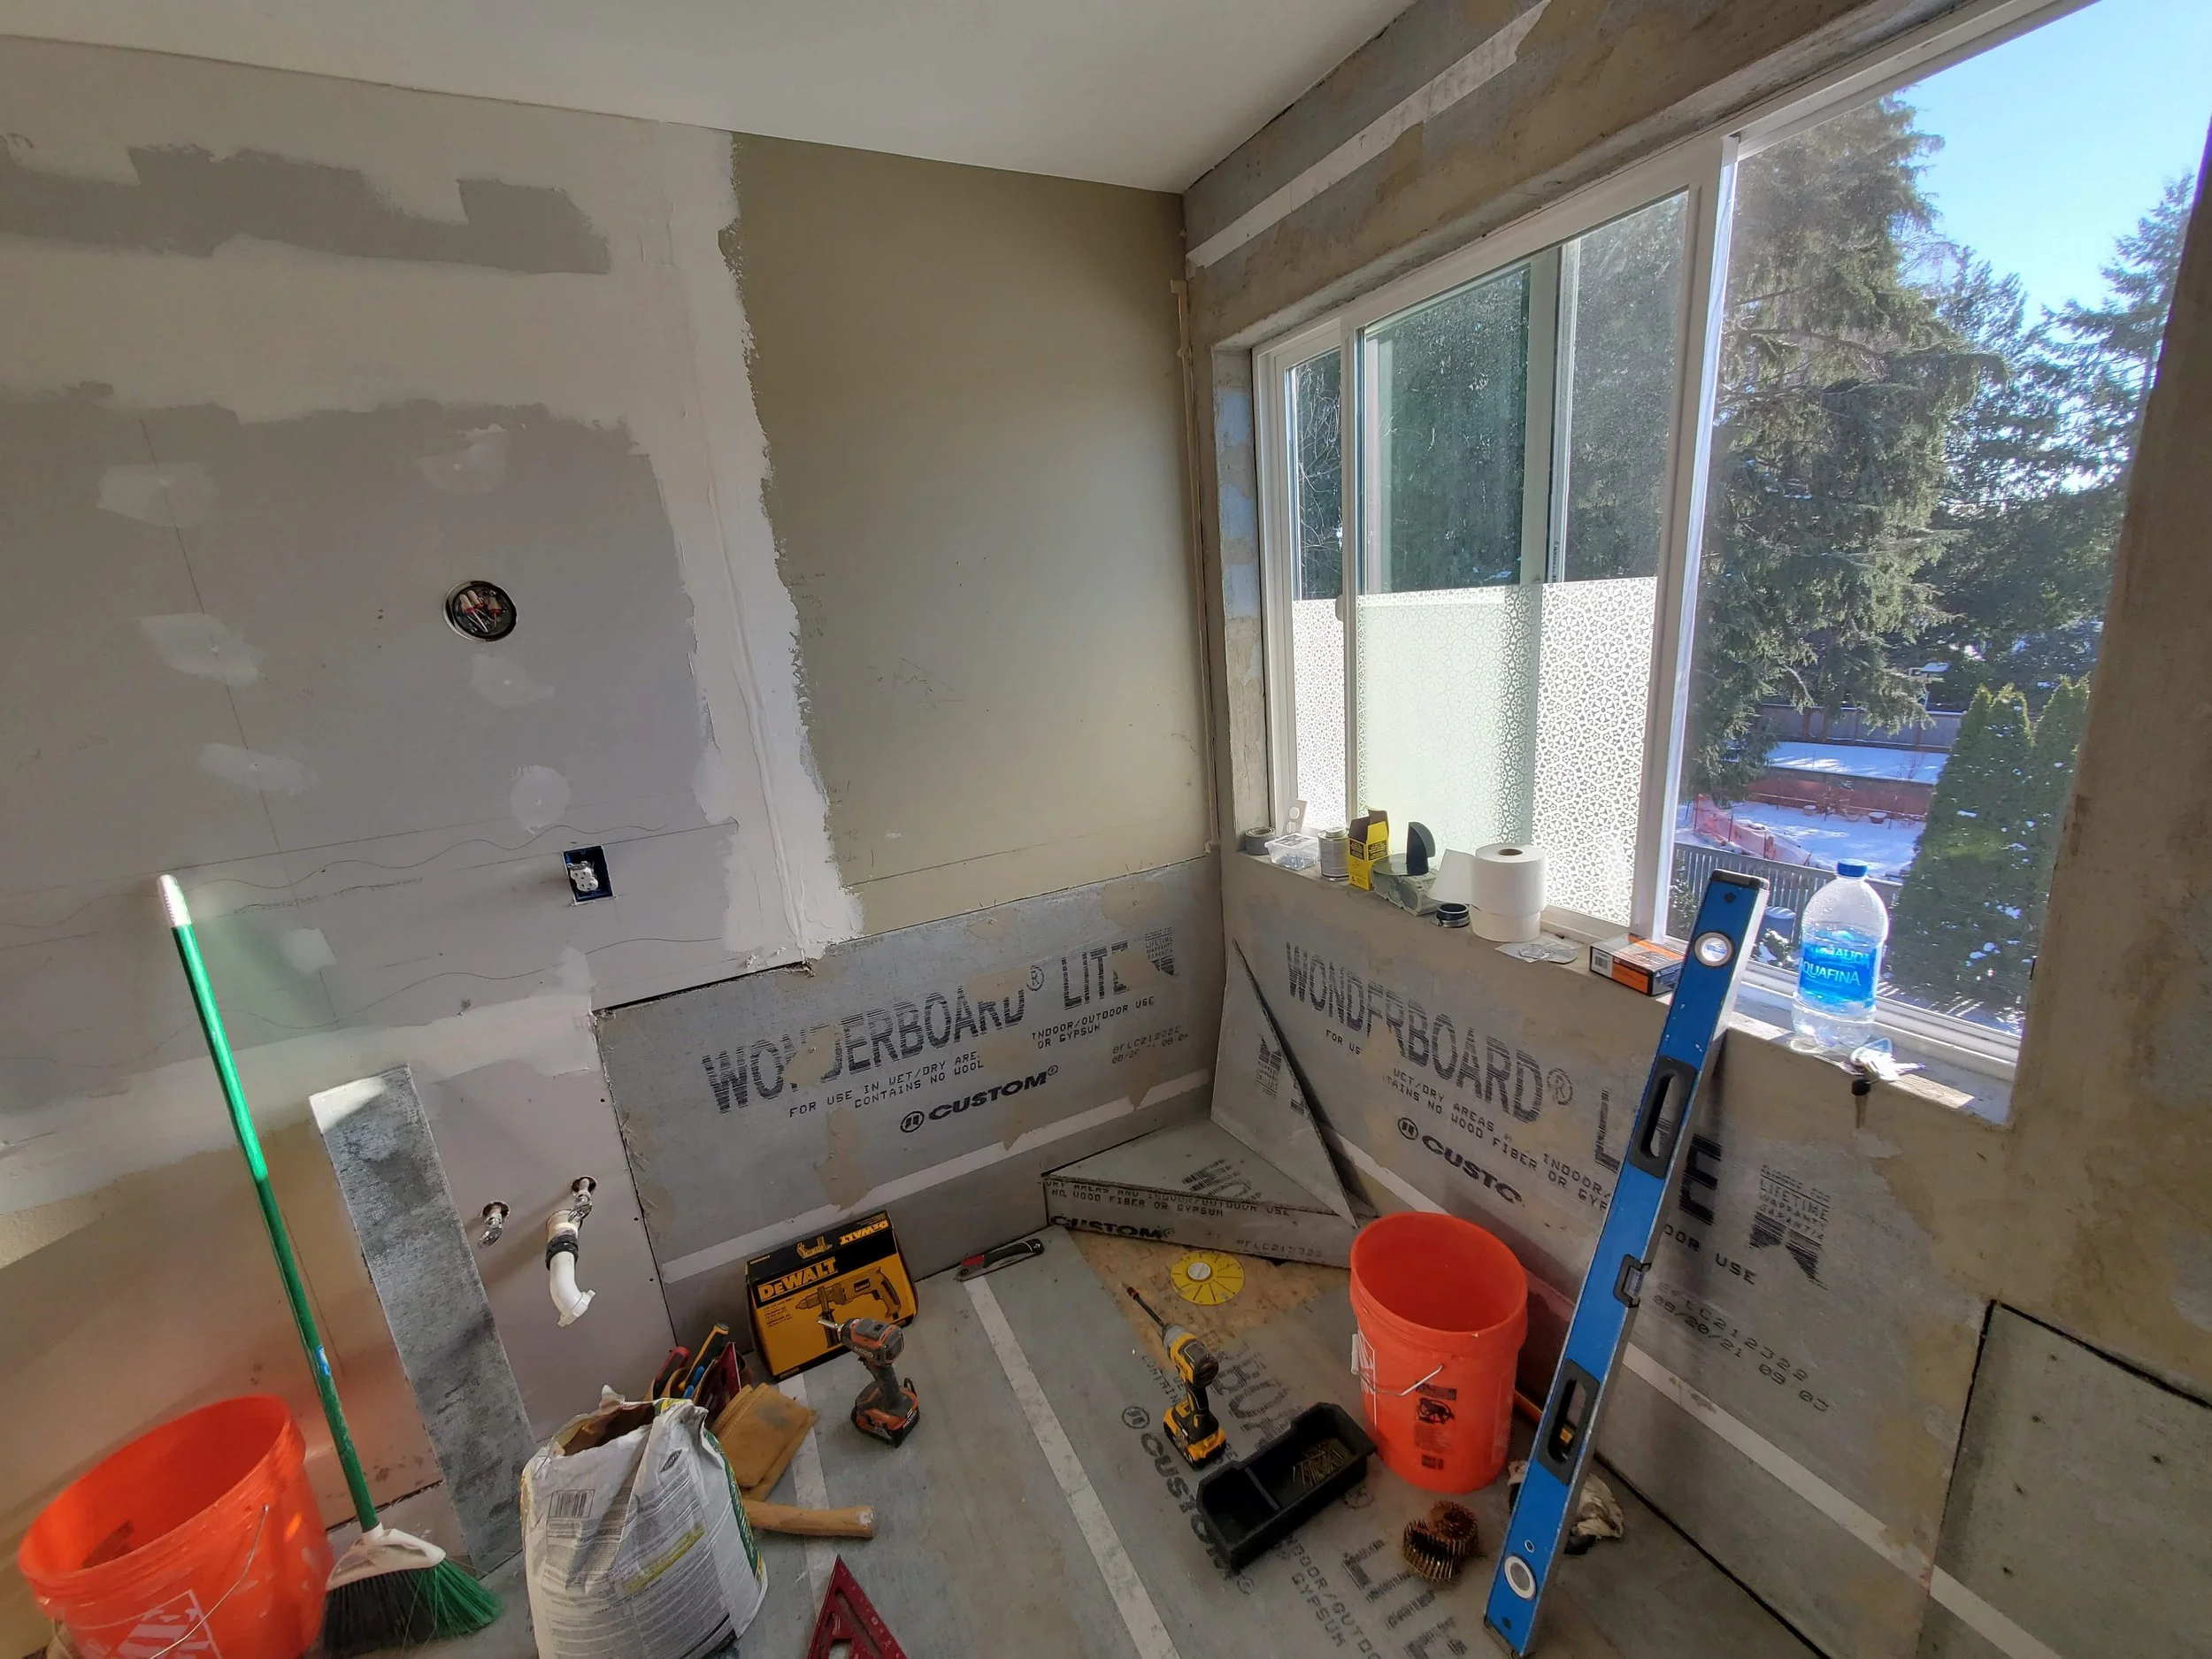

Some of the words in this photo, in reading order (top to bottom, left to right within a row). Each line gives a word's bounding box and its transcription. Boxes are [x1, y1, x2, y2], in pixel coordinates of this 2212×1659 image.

[702, 986, 1025, 1114] WOERBOARD
[789, 1102, 817, 1118] FOR
[826, 1090, 853, 1105] USE
[864, 1081, 879, 1094] IN
[888, 1061, 946, 1086] WET/DRY
[955, 1051, 979, 1064] ARE
[1135, 996, 1155, 1009] USE
[855, 1080, 921, 1108] CONTAINS
[930, 1072, 946, 1085] NO
[1038, 1038, 1051, 1049] OR
[929, 1071, 1047, 1120] CUSTOM
[1326, 1029, 1343, 1045] FOR
[1349, 1044, 1363, 1056] US
[1394, 1068, 1445, 1102] WET/DRY
[1453, 1102, 1494, 1132] AREAS
[1716, 1252, 1756, 1285] USE
[1422, 1135, 1524, 1204] CUSTO
[1427, 1101, 1443, 1114] NO
[1451, 1113, 1484, 1139] WOOD
[1493, 1137, 1538, 1171] FIBER
[1548, 1170, 1567, 1189] OR
[840, 1220, 889, 1245] DEWALT
[1109, 1195, 1146, 1208] FIBER
[1154, 1201, 1169, 1210] OR
[757, 1257, 836, 1302] DEWALT
